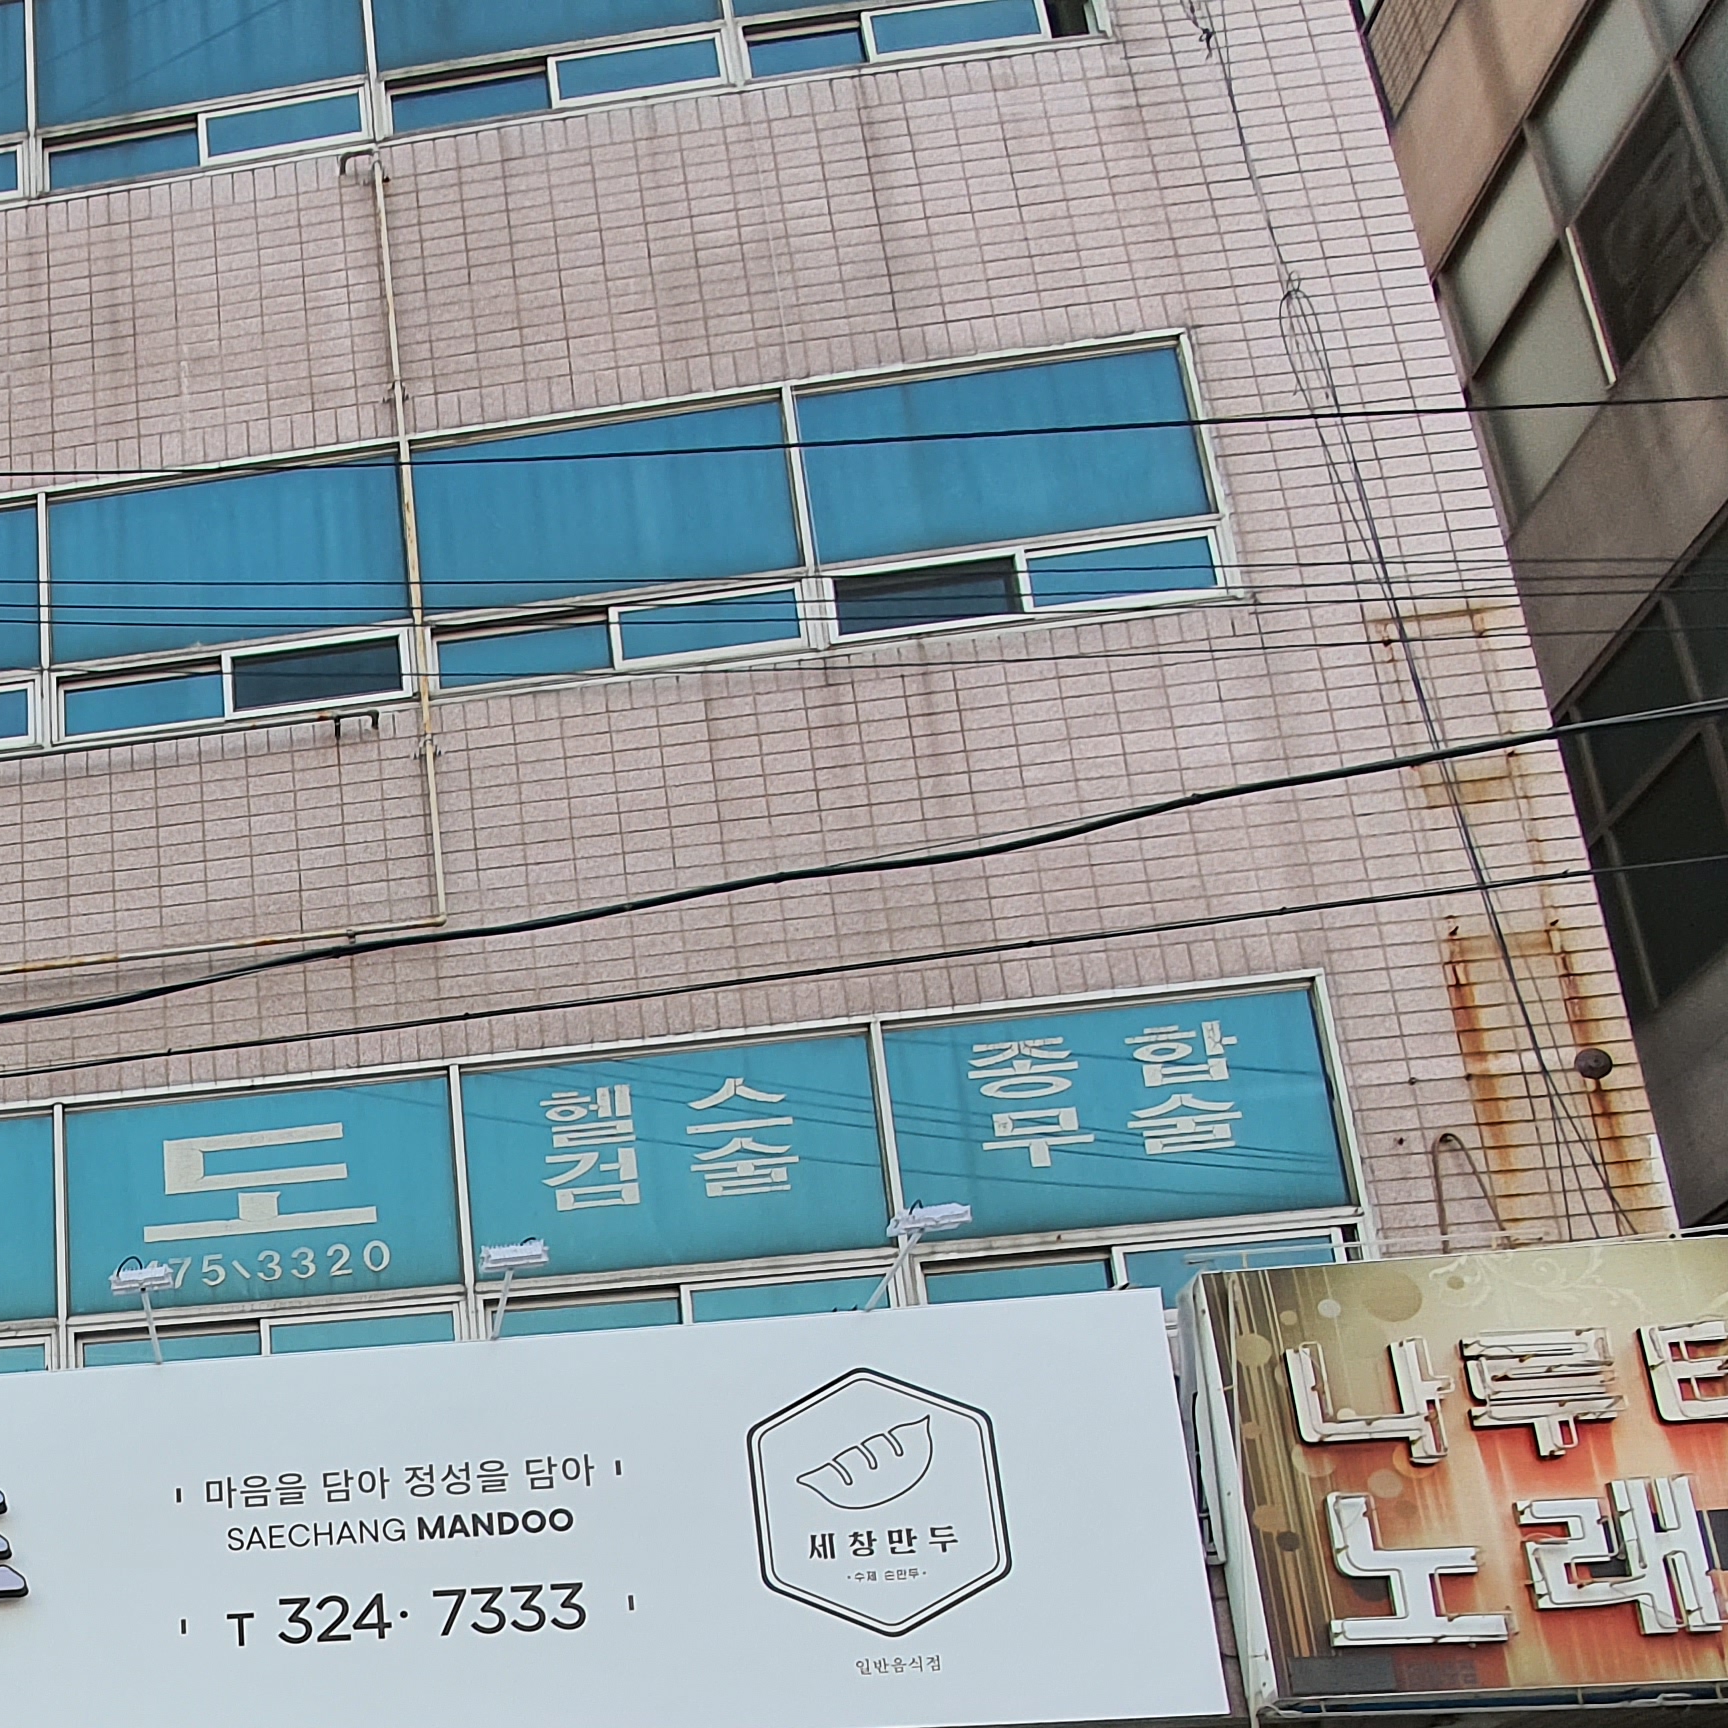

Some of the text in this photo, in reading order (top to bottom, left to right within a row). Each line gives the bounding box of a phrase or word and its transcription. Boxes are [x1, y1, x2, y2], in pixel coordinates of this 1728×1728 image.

[205, 1453, 595, 1509] 마음을 담아 정성을 담아
[226, 1508, 574, 1551] SAECHANG MANDOO
[809, 1525, 959, 1560] 세창만두
[226, 1612, 255, 1647] T
[432, 1581, 587, 1636] 7333
[855, 1654, 942, 1676] 일반음식점
